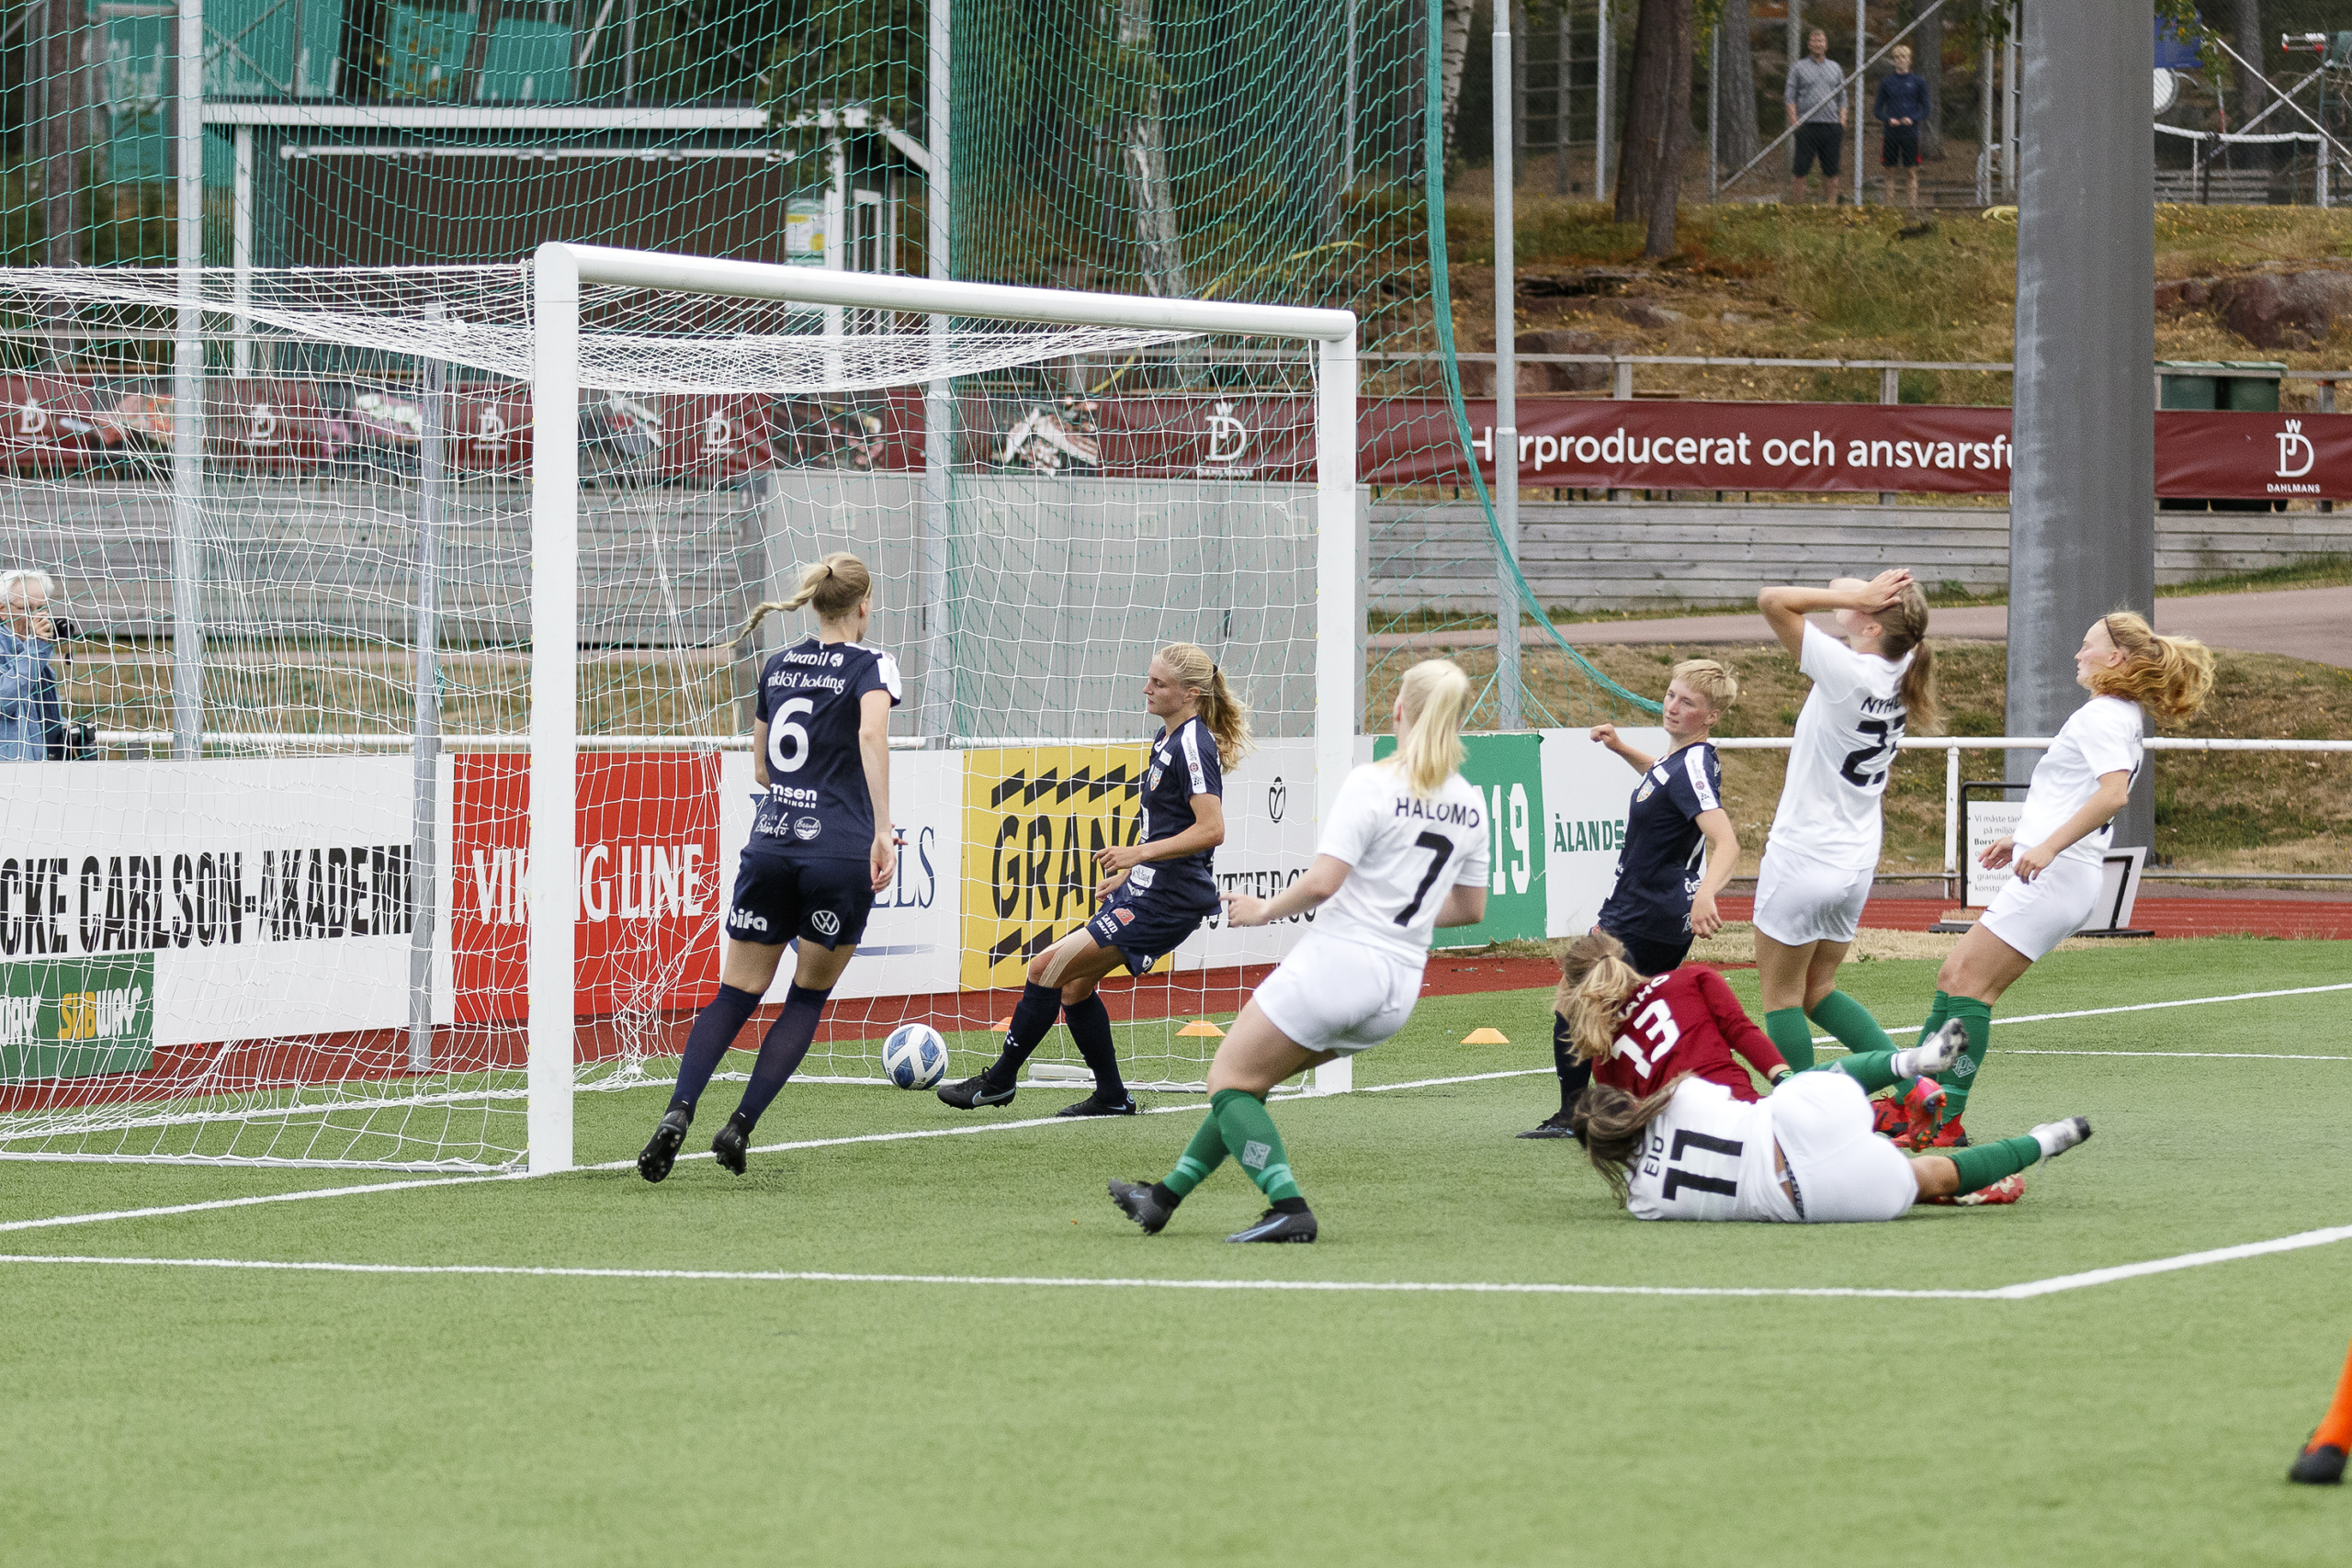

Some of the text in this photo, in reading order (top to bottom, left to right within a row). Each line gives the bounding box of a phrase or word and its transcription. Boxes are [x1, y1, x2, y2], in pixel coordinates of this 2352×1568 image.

[1469, 426, 2012, 471] Hrproducerat och ansvarsf
[2267, 483, 2321, 494] DAHLMANS
[768, 697, 813, 773] 6
[770, 784, 817, 801] msen
[0, 844, 412, 955] CKE CARLSON-AKADEMI
[620, 844, 703, 919] LINE
[992, 805, 1141, 921] GRAN
[1394, 831, 1454, 928] 7
[729, 905, 768, 931] bifa
[57, 982, 143, 1040] SUBWAY
[1611, 998, 1680, 1079] 13
[1662, 1129, 1744, 1201] 11
